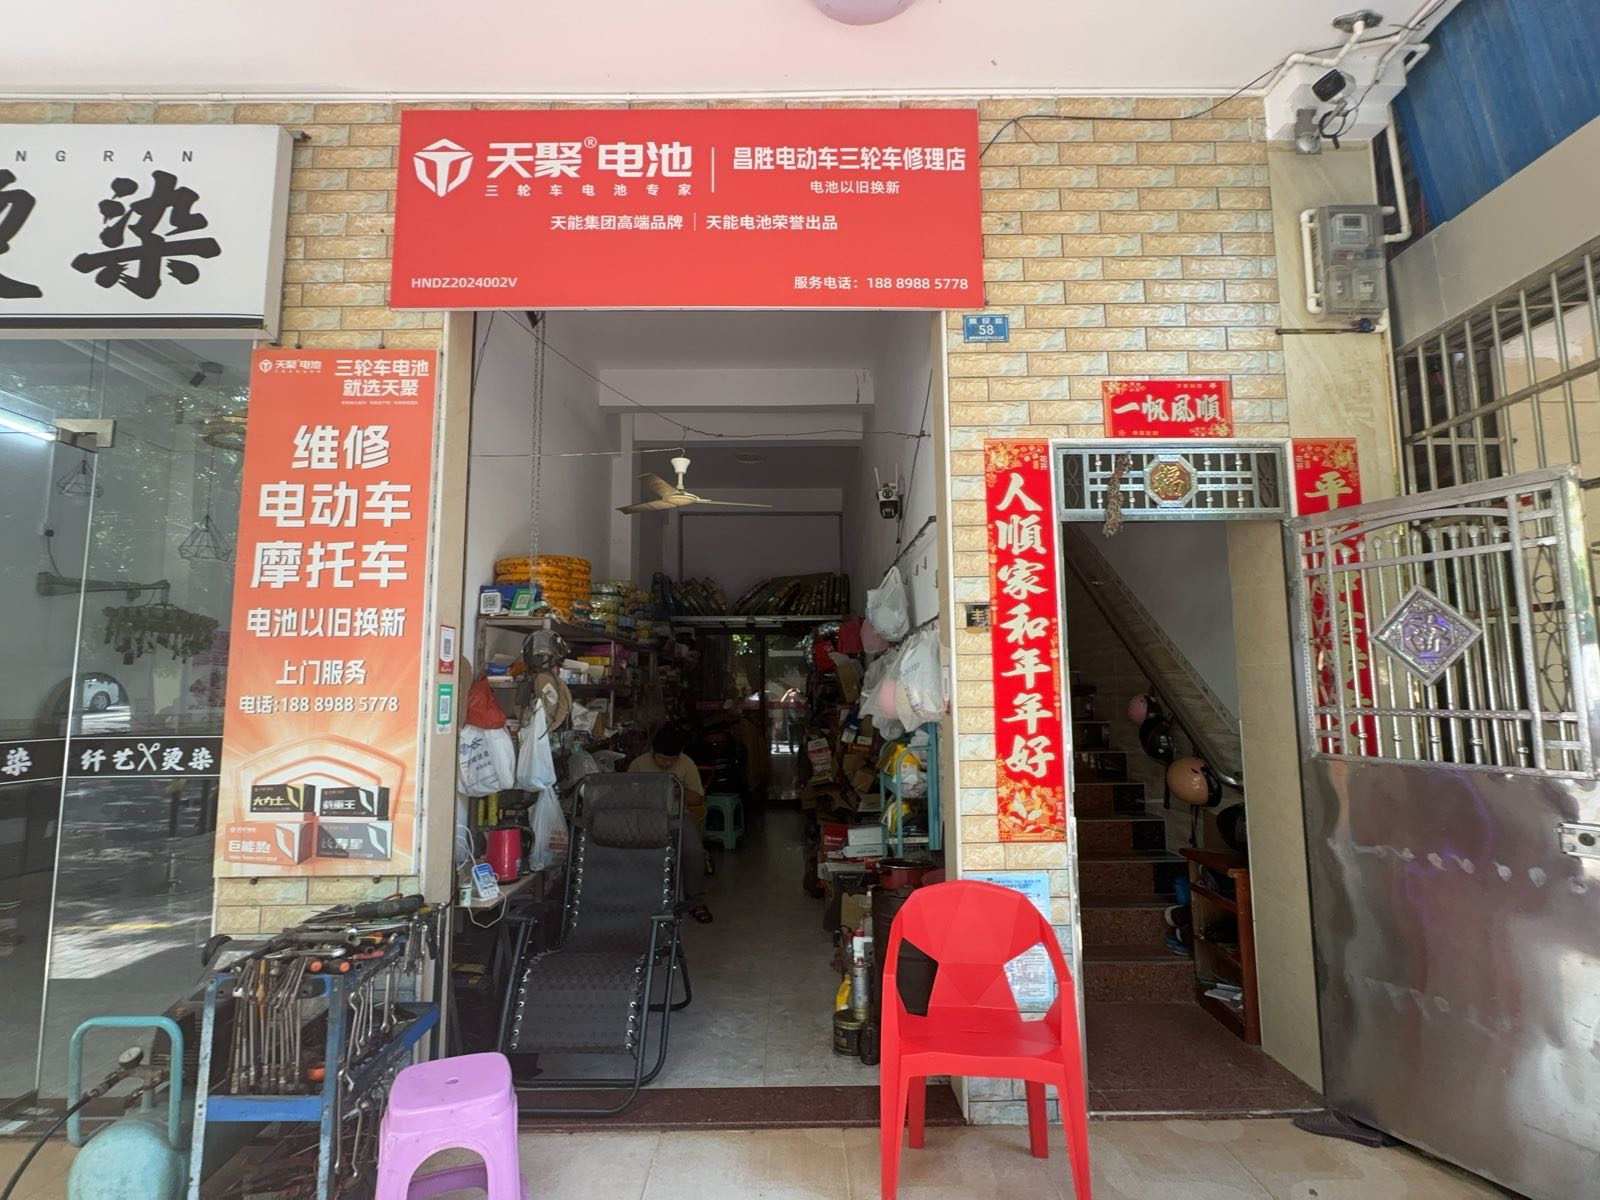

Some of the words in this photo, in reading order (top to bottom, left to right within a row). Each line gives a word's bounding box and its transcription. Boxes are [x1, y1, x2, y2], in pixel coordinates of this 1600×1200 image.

[733, 146, 966, 171] 昌胜电动车三轮车修理店
[484, 183, 692, 197] 三轮车电池专家
[809, 180, 900, 194] 电池以旧换新
[550, 215, 684, 231] 天能集团高端品牌
[705, 215, 838, 230] 天能电池荣誉出品
[411, 277, 518, 288] HNDZ2024002V
[867, 277, 892, 289] 188
[896, 278, 930, 289] 8988
[934, 278, 968, 290] 5778
[979, 324, 994, 335] 58
[334, 359, 429, 377] 三轮车电池
[343, 379, 419, 396] 就选天聚
[291, 425, 391, 470] 维修
[258, 481, 412, 528] 电动车
[250, 540, 408, 588] 摩托车
[246, 607, 406, 638] 电池以旧换新
[995, 472, 1056, 778] 人順家和年年好
[275, 659, 367, 686] 上门服务
[314, 696, 355, 713] 8988
[359, 696, 399, 712] 5778
[161, 747, 214, 771] 烫染
